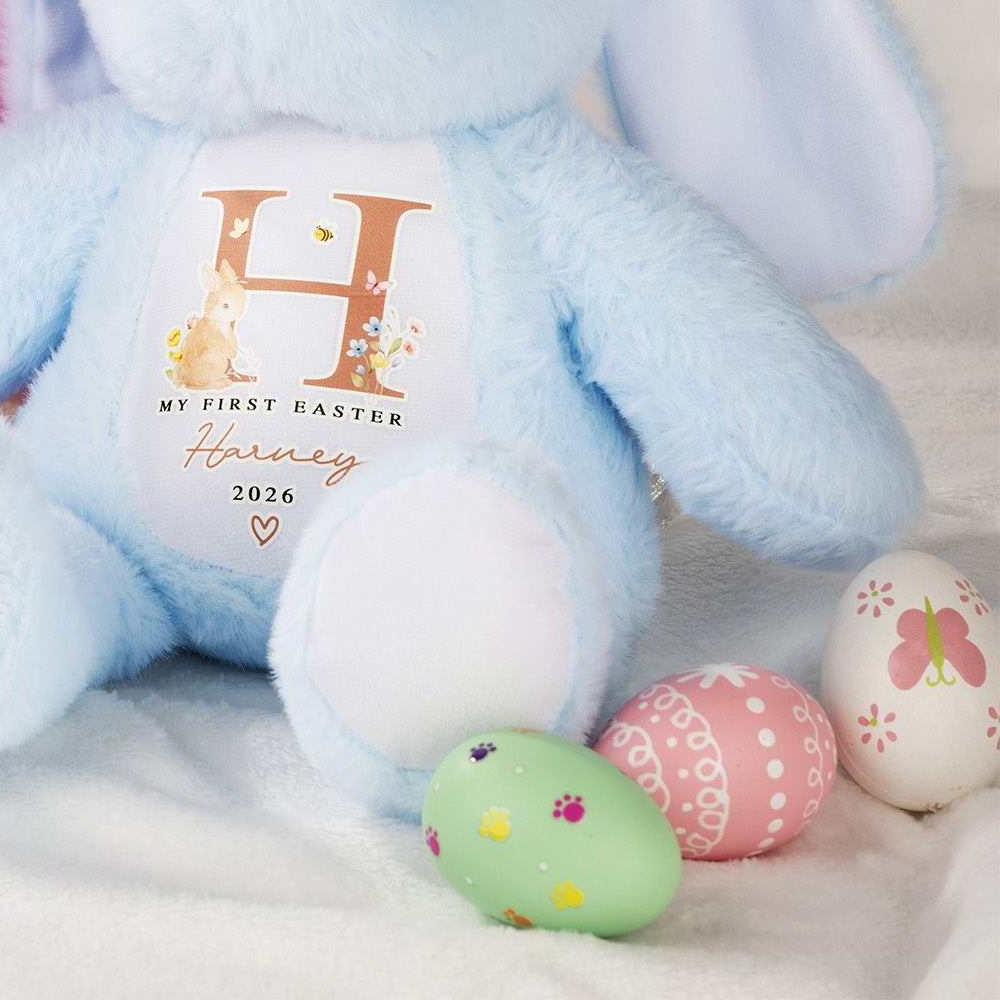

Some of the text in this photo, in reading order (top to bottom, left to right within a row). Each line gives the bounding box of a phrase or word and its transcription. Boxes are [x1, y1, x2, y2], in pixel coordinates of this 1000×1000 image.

[201, 189, 433, 399] H
[158, 397, 403, 427] MY FIRST EASTER
[232, 485, 295, 505] 2026
